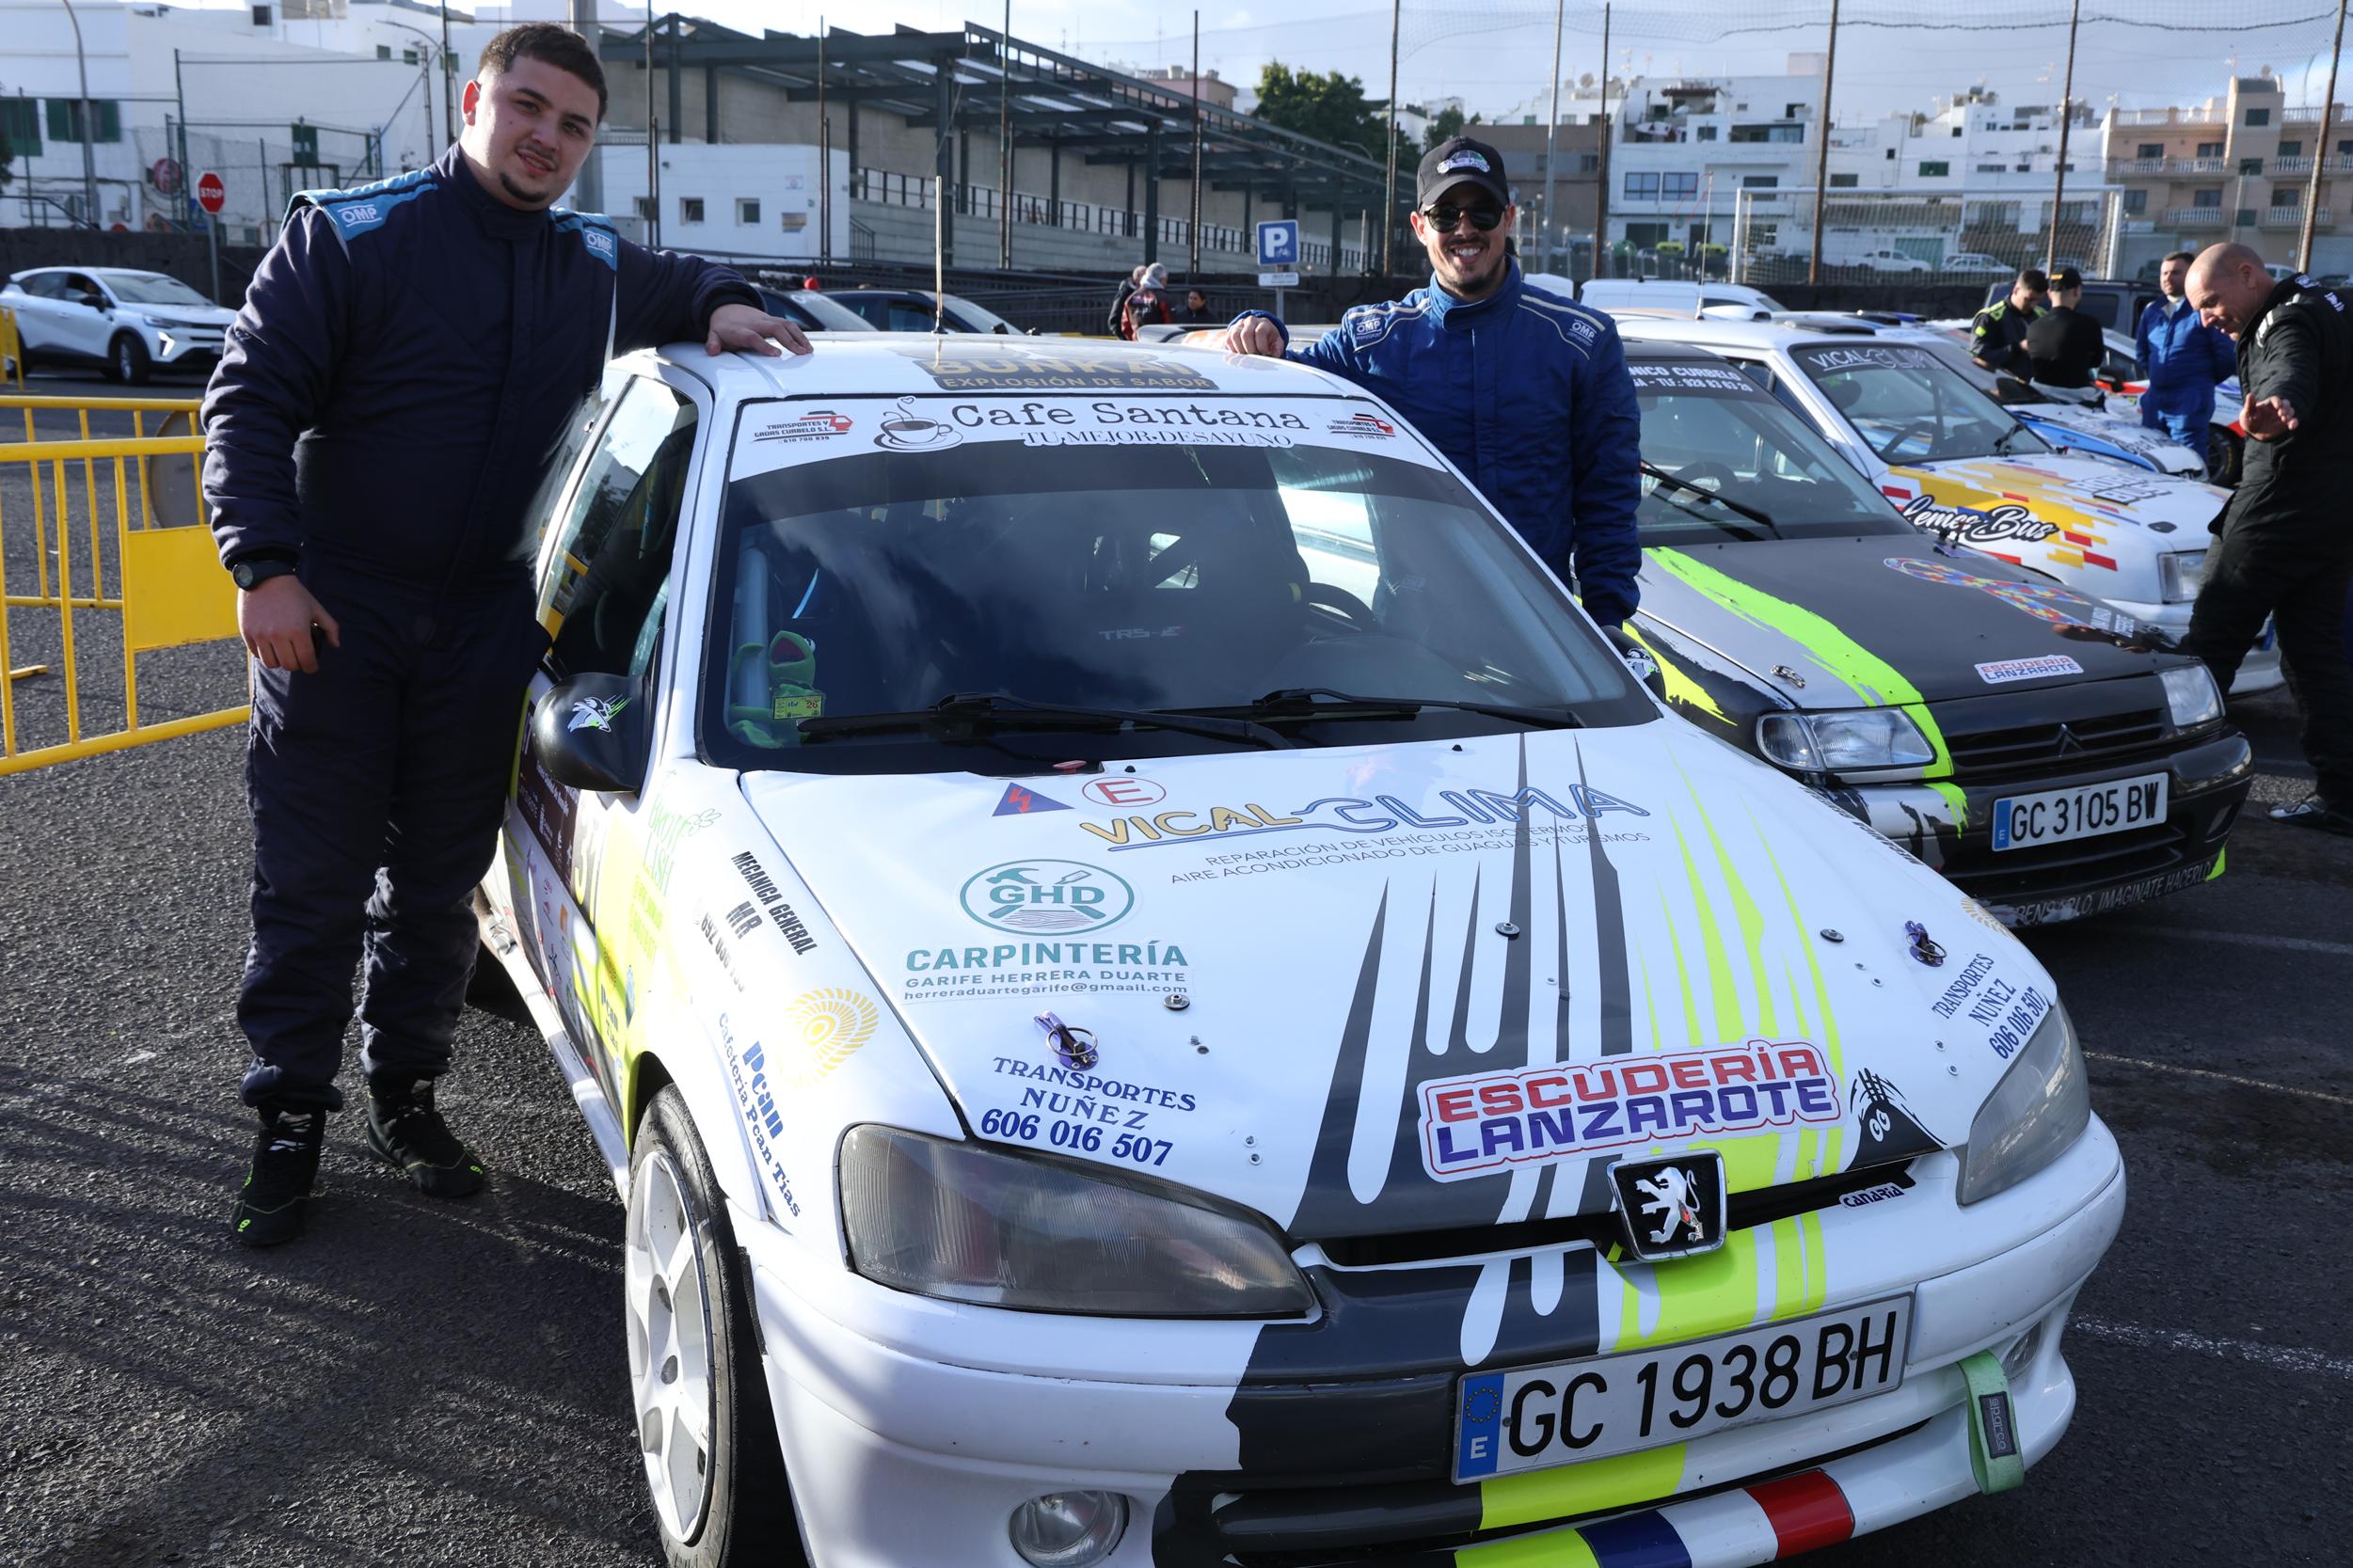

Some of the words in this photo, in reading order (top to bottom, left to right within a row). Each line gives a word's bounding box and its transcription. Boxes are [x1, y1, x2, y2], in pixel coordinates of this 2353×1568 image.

[200, 187, 223, 199] STOP
[342, 205, 377, 223] OMP
[586, 233, 612, 252] OMP
[1264, 227, 1289, 259] P
[1357, 320, 1381, 333] OMP
[1572, 322, 1595, 339] OMP
[942, 376, 1083, 388] EXPLOSIÓN
[1094, 377, 1126, 388] DE
[1130, 376, 1211, 388] SABOR
[1672, 367, 1742, 381] CURBELO
[951, 403, 1075, 428] Cafe
[1092, 402, 1311, 430] Santana
[1970, 504, 2059, 540] Bus
[1985, 663, 2078, 680] LANZAROTE
[1094, 780, 1154, 804] E
[1079, 803, 1303, 845] VICAL
[1291, 784, 1650, 833] CLIMA
[2011, 801, 2046, 842] GC
[2053, 788, 2120, 832] 3105
[2126, 782, 2159, 824] BW
[1205, 843, 1337, 867] REPARACIÓN
[1340, 839, 1373, 850] DE
[1370, 830, 1484, 847] VEHÍCULOS
[1998, 829, 2006, 842] E
[1170, 869, 1219, 884] AIRE
[1222, 847, 1407, 878] ACONDICIONADO
[1408, 845, 1441, 856] DE
[731, 850, 783, 906] MECANICA
[768, 903, 818, 956] GENERAL
[989, 884, 1105, 906] GHD
[725, 900, 763, 940] MR
[906, 940, 1189, 972] CARPINTERÍA
[905, 974, 983, 989] GARIFE
[991, 969, 1091, 984] HERRERA
[1100, 970, 1185, 983] DUARTE
[1932, 953, 1995, 1020] TRANSPORTES
[2022, 986, 2046, 1019] 507
[2010, 1003, 2035, 1037] 016
[1989, 1024, 2020, 1060] 606
[993, 1056, 1197, 1113] TRANSPORTES
[1437, 1046, 1820, 1123] ESCUDERÍA
[1020, 1087, 1151, 1131] NUÑEZ
[1436, 1078, 1833, 1164] LANZAROTE
[981, 1108, 1041, 1141] 606
[1049, 1119, 1104, 1152] 016
[1111, 1132, 1174, 1167] 507
[1508, 1371, 1609, 1458] GC
[1636, 1340, 1802, 1438] 1938
[1812, 1310, 1897, 1402] BH
[1988, 1398, 2007, 1451] sparco
[1470, 1435, 1489, 1460] E
